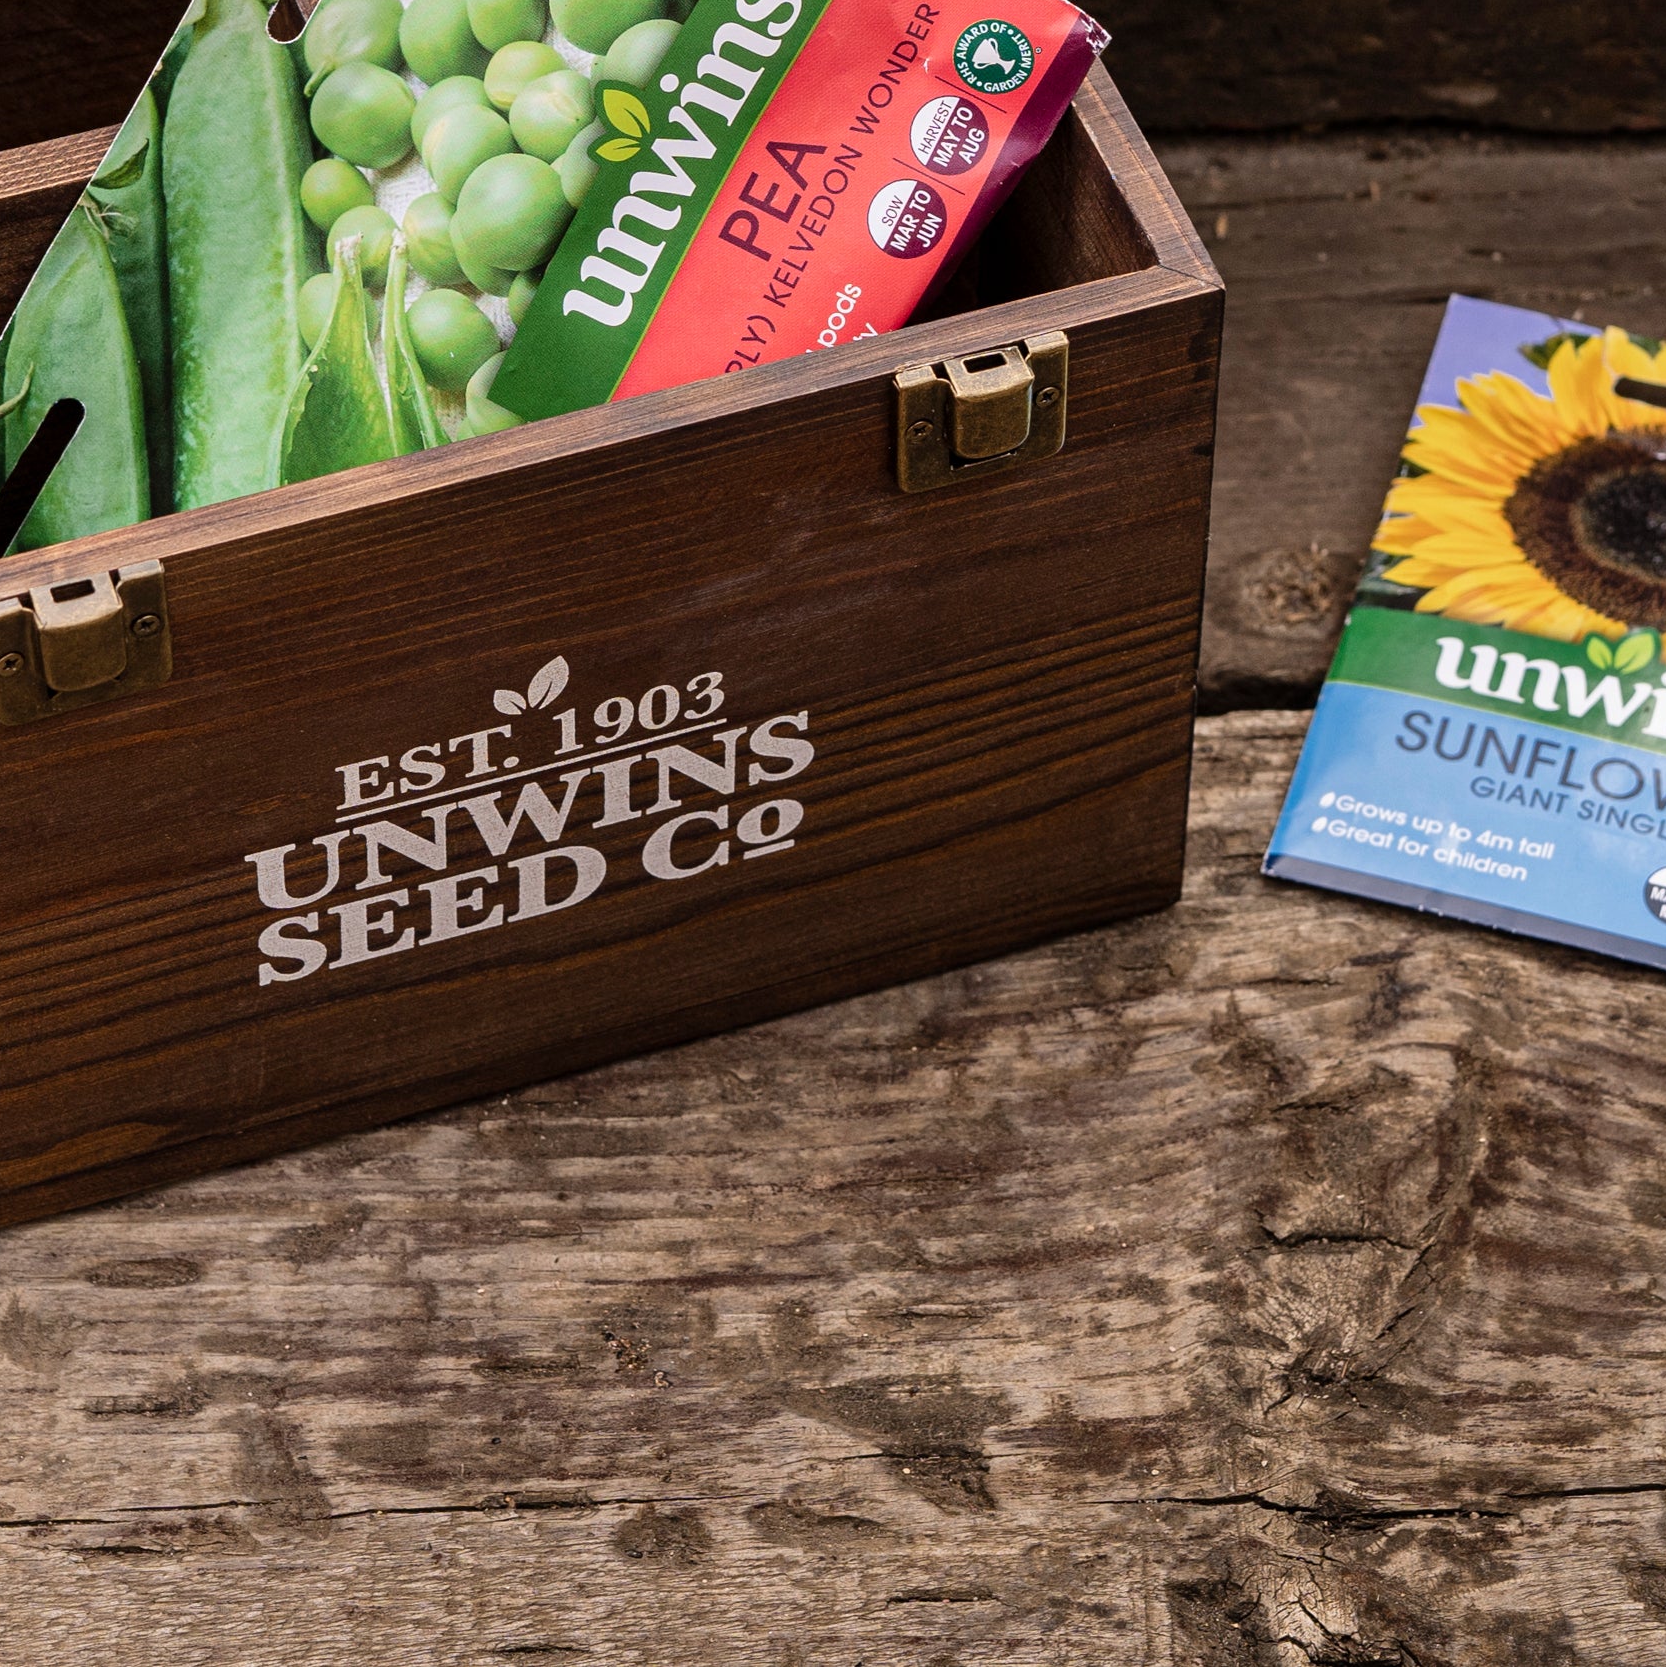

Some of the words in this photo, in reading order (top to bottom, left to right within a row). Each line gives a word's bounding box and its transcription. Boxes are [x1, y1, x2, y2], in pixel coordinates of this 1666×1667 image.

[956, 23, 989, 59] AWARD
[990, 22, 1008, 34] OF
[957, 61, 977, 84] RHS
[983, 69, 1028, 93] GARDEN
[1011, 33, 1032, 69] MERIT
[763, 143, 863, 308] KELVEDON
[849, 3, 941, 134] WONDER
[918, 100, 952, 154] HARVEST
[933, 129, 961, 167] MAY
[950, 107, 973, 129] TO
[958, 128, 986, 164] AUG
[718, 141, 828, 262] PEA
[881, 195, 904, 226] SOW
[890, 213, 920, 251] MAR
[909, 189, 931, 212] TO
[916, 213, 943, 248] JUN
[817, 283, 862, 348] pods
[335, 724, 520, 810] EST.
[553, 671, 726, 756] 1903
[244, 710, 815, 910] UNWINS
[1469, 775, 1570, 815] GIANT
[1328, 818, 1394, 849] Great
[1397, 836, 1429, 857] for
[1434, 846, 1527, 882] children
[1335, 794, 1407, 826] Grows
[1412, 814, 1443, 835] up
[1448, 821, 1472, 842] to
[1476, 830, 1514, 851] 4m
[1518, 836, 1555, 860] tall
[257, 845, 607, 986] SEED
